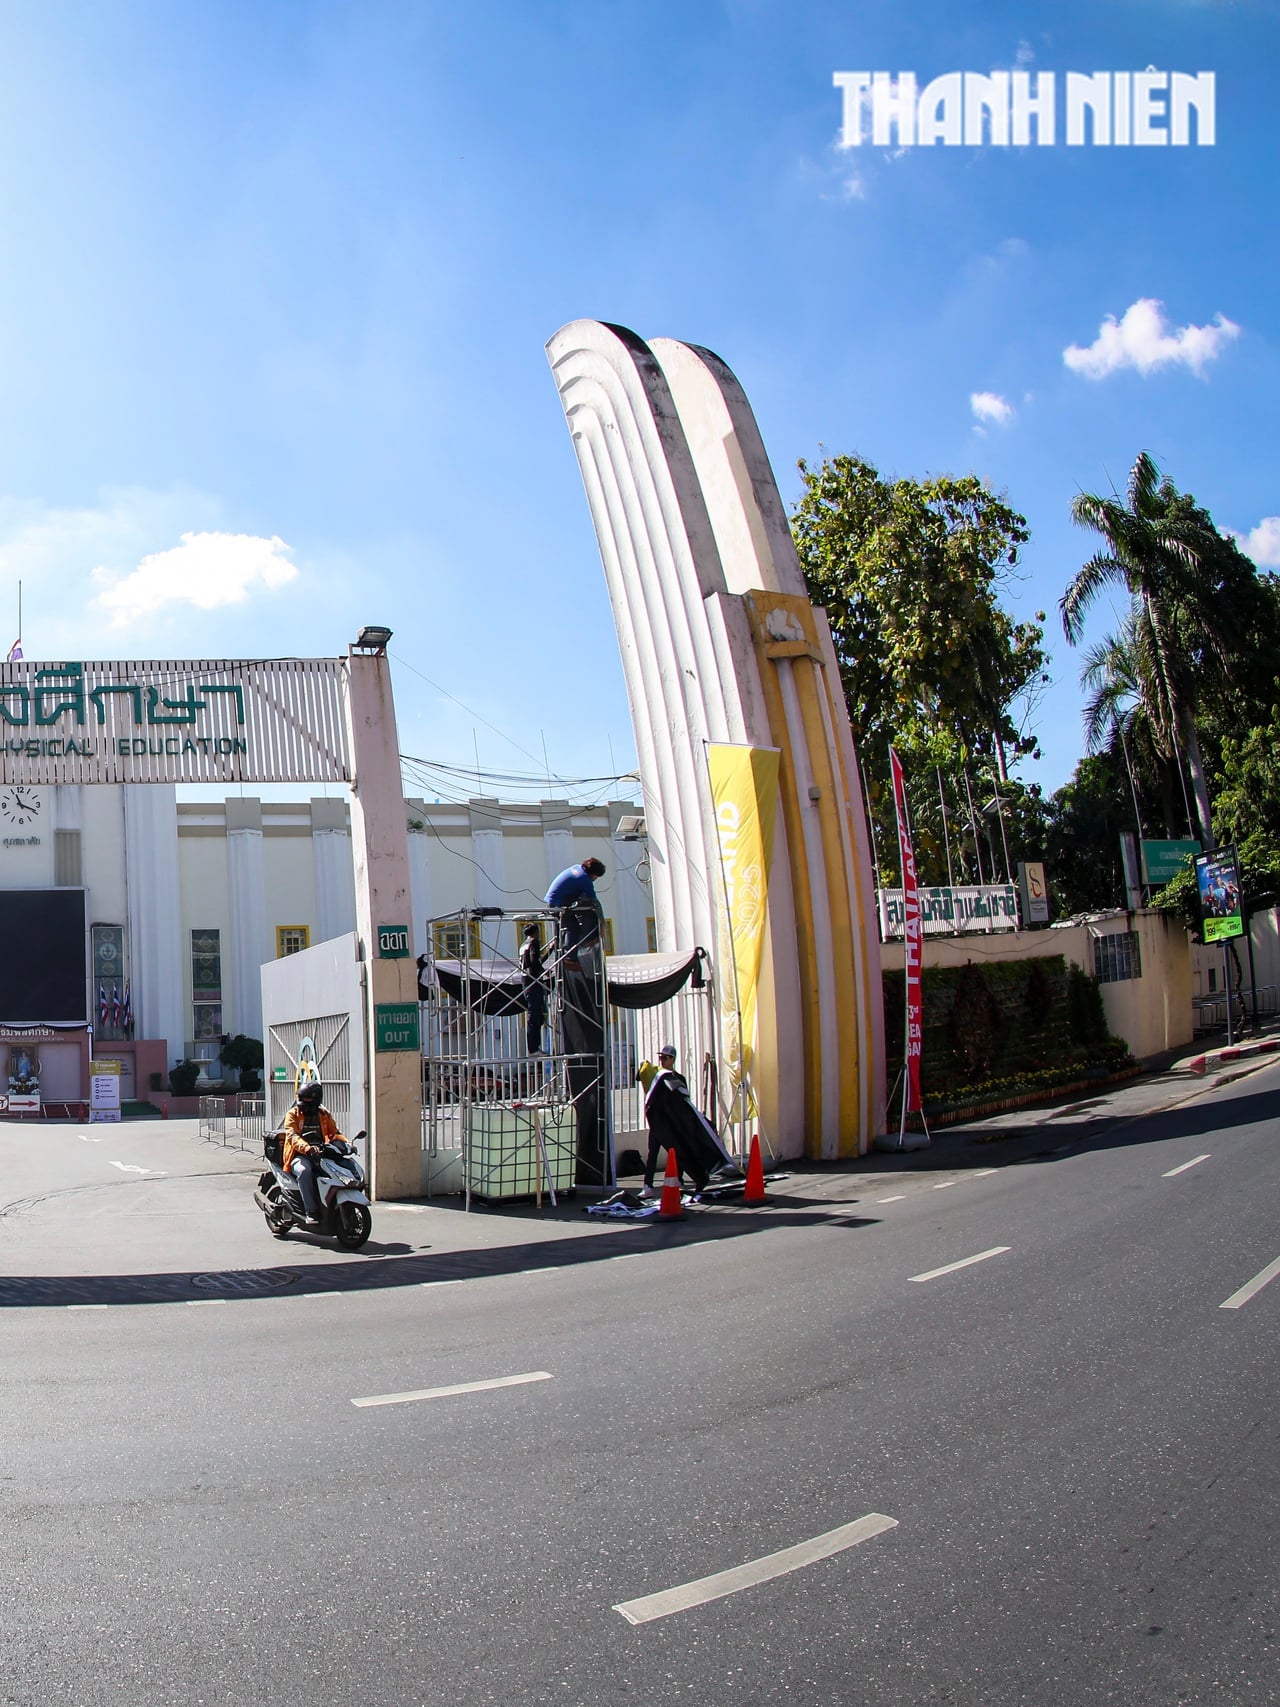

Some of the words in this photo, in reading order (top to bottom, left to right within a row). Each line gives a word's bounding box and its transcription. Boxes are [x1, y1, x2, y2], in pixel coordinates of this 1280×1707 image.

[118, 737, 248, 756] EDUCATION
[18, 817, 24, 825] 6
[380, 932, 409, 950] ออก
[378, 1012, 416, 1025] ทางออก
[384, 1031, 410, 1043] OUT
